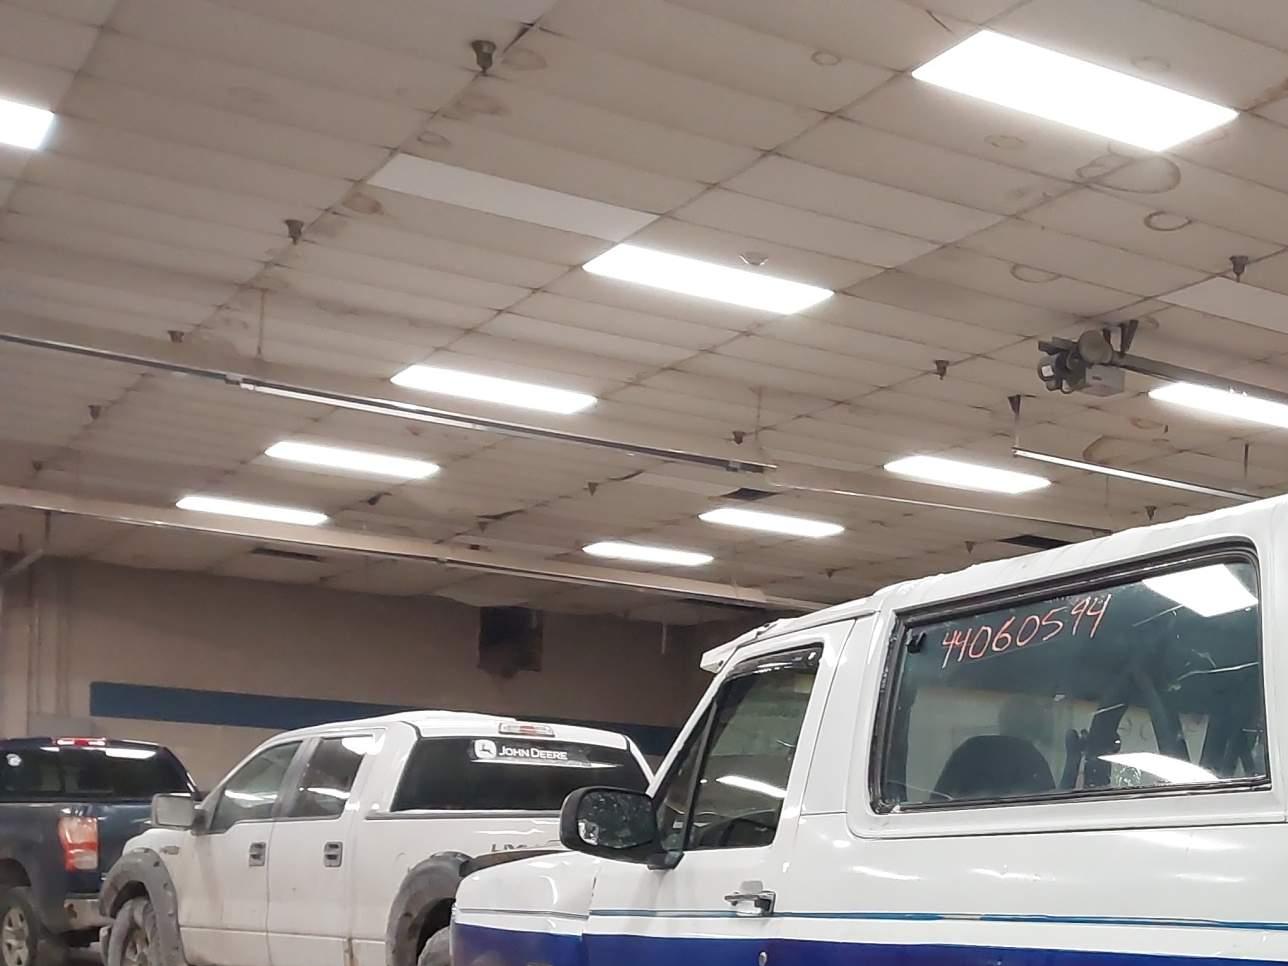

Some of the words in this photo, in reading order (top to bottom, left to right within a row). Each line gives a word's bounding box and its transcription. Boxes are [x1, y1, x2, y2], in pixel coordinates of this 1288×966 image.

[942, 594, 1112, 669] 44060594
[499, 745, 530, 758] JOHN
[531, 748, 568, 760] DEERE
